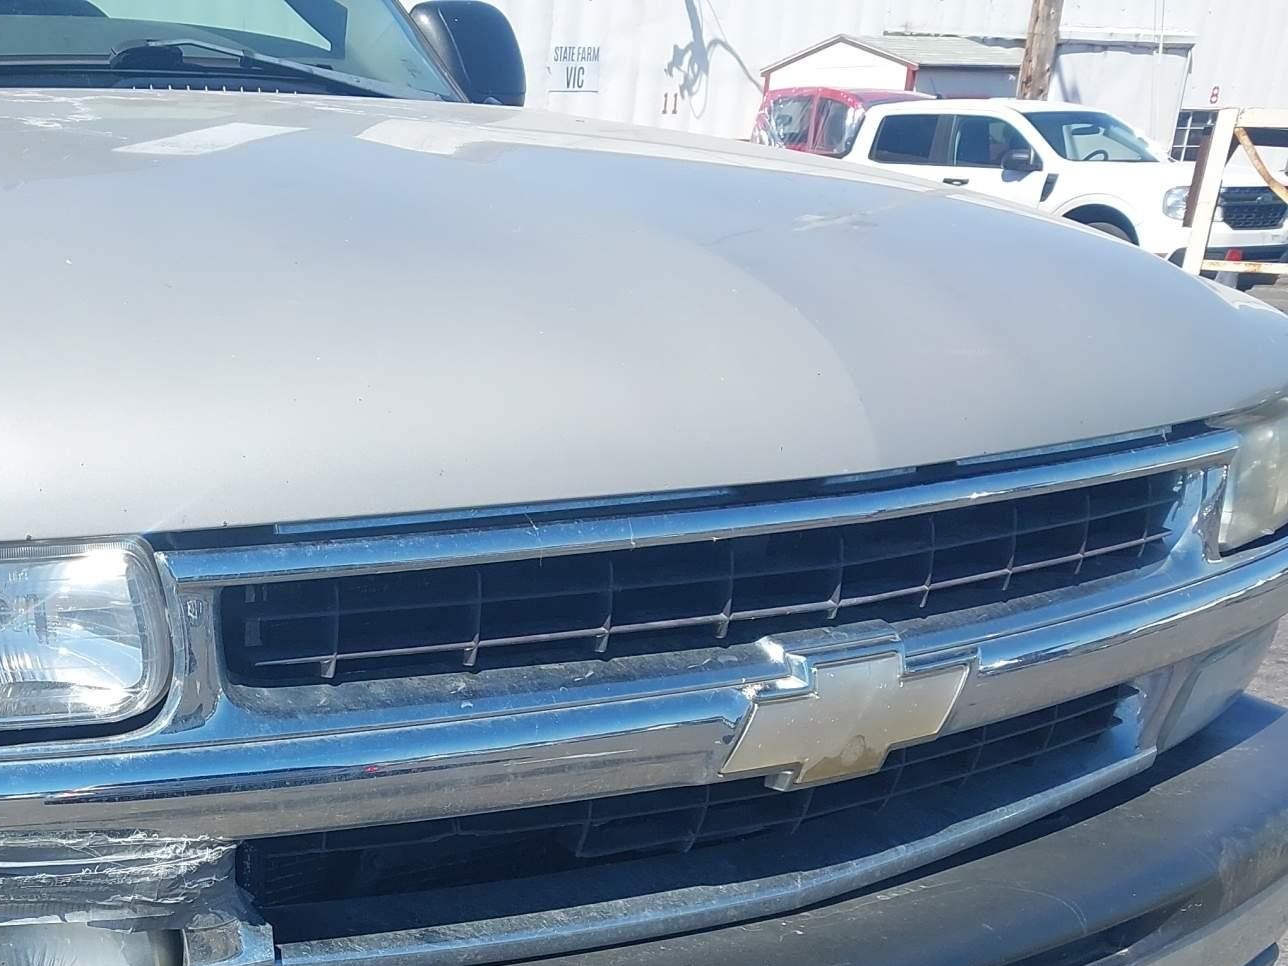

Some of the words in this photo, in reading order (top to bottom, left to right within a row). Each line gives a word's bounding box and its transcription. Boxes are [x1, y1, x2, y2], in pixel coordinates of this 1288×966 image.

[553, 46, 576, 62] STATE
[576, 46, 600, 62] FARM
[566, 66, 585, 89] VIC
[661, 92, 678, 115] 11
[1209, 85, 1220, 105] 8
